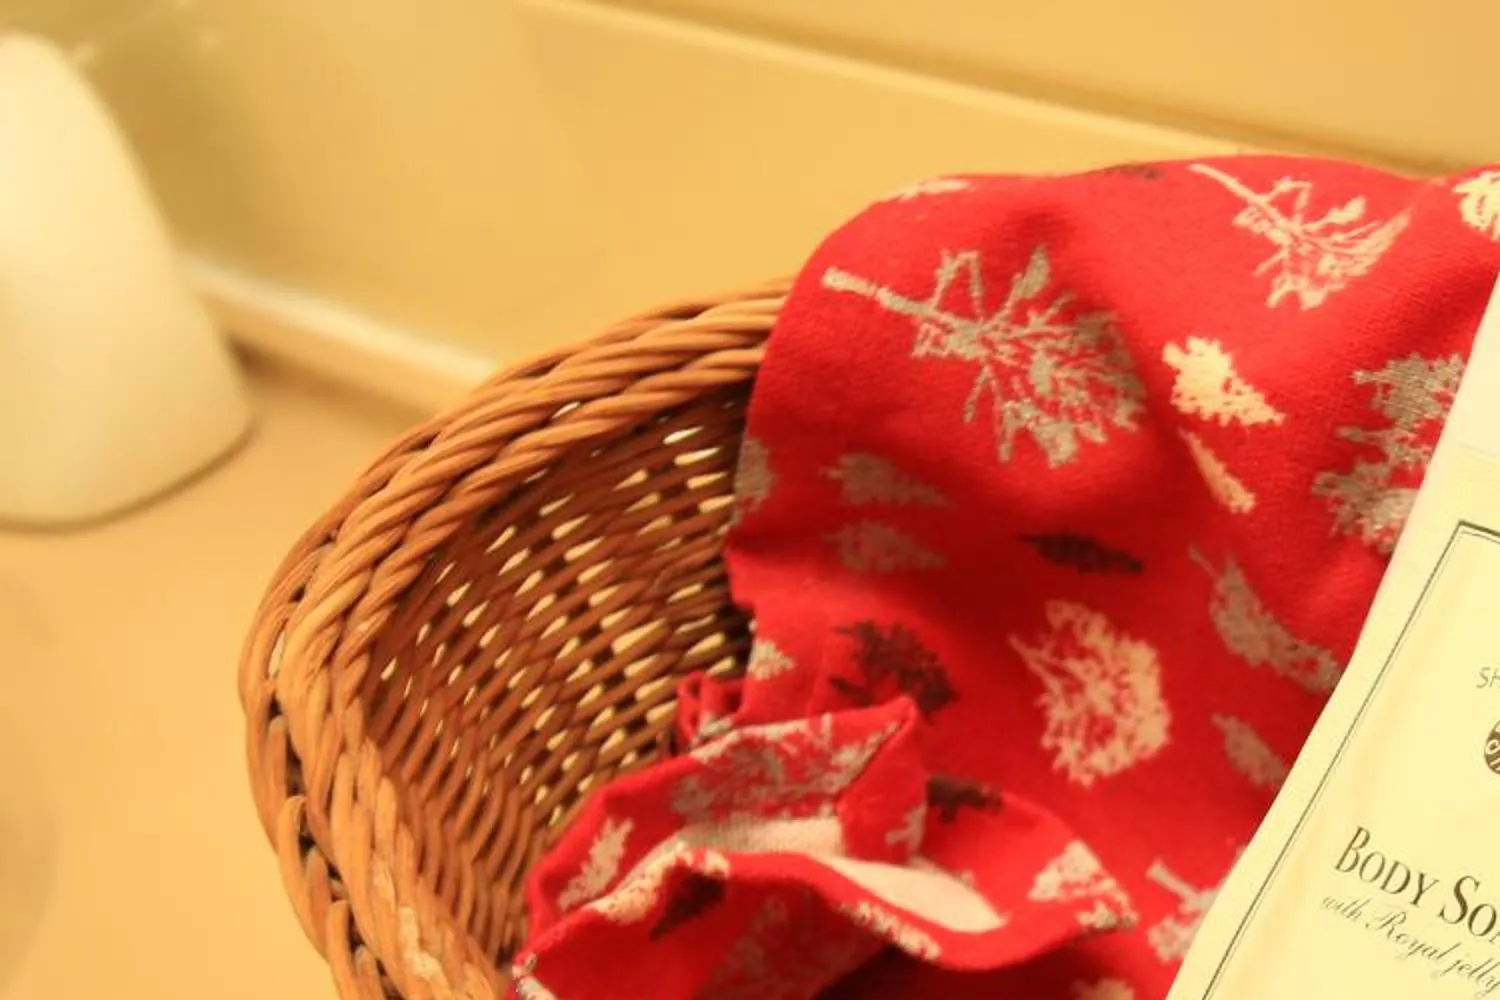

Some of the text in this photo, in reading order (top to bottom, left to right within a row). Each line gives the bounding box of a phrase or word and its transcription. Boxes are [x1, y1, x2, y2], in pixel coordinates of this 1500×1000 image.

[1334, 826, 1439, 908] BODY
[1321, 892, 1366, 925] with
[1365, 910, 1450, 965] Royal
